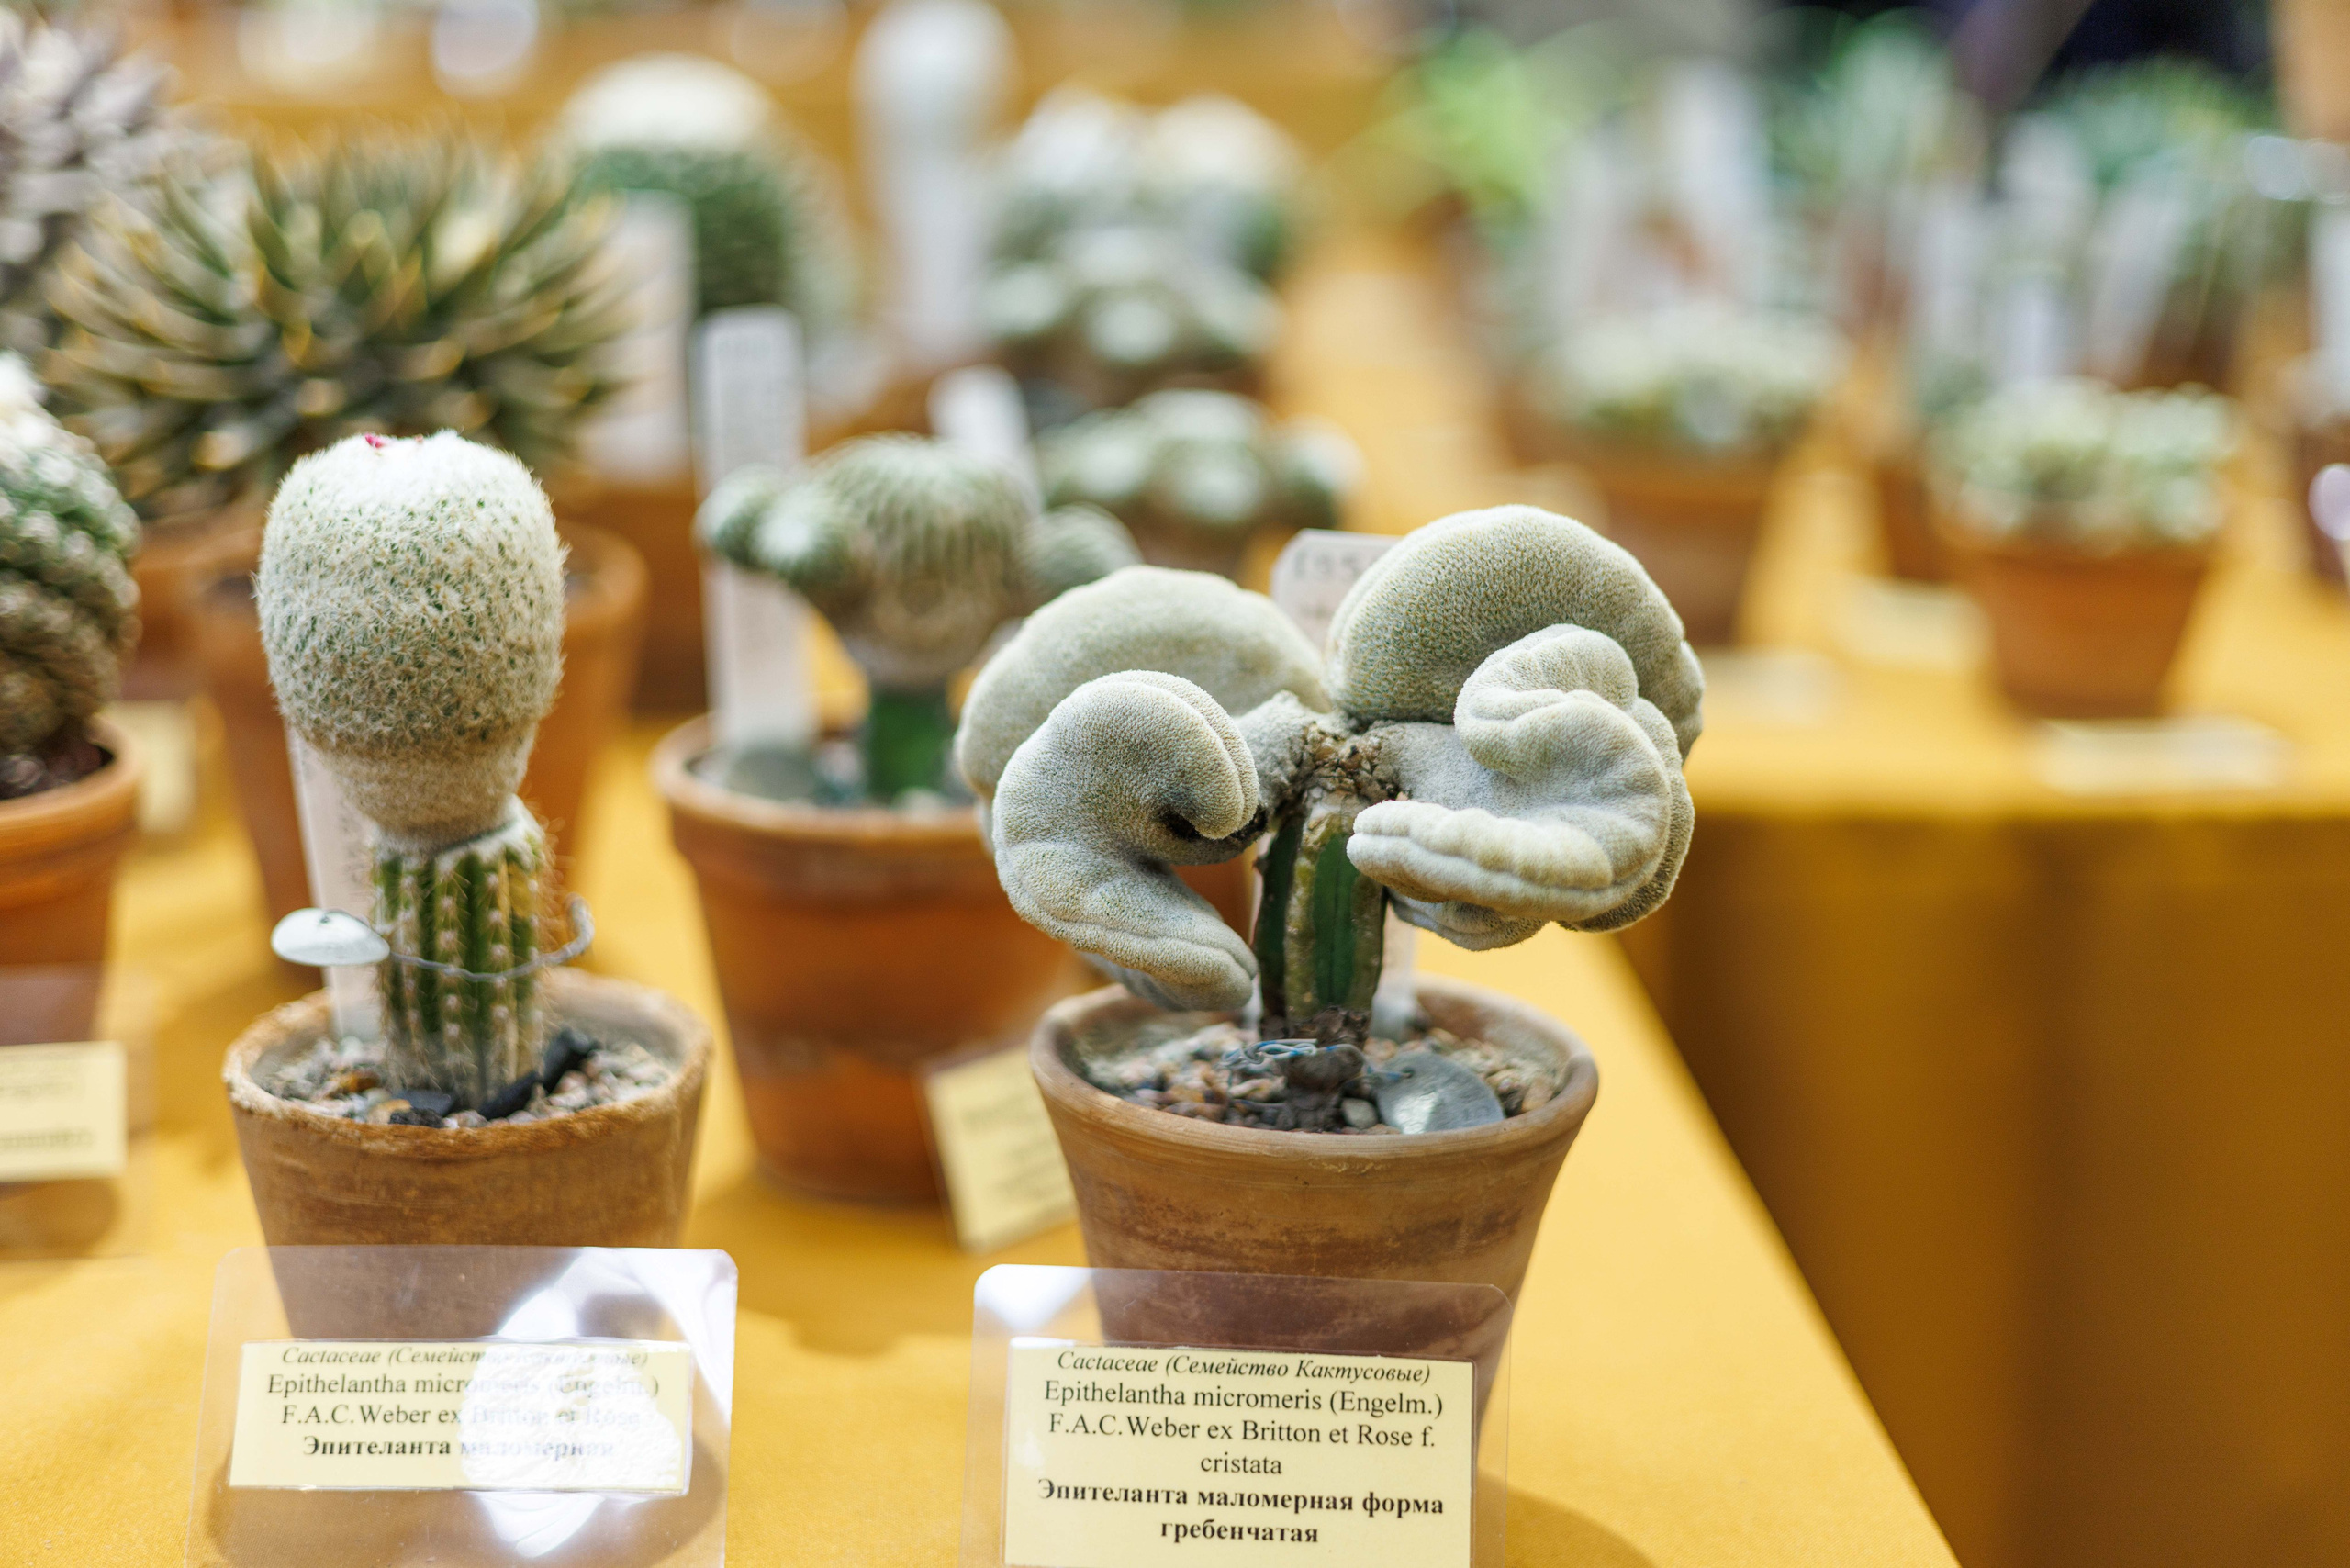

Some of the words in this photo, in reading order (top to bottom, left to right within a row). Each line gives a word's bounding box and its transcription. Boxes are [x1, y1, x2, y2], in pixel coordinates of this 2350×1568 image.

[283, 1346, 381, 1363] Cactaceae
[1058, 1350, 1158, 1372] Cactaceae
[1165, 1354, 1289, 1377] (Семейство
[1295, 1359, 1430, 1385] Кактусовые)
[268, 1373, 406, 1398] Epithelantha
[1045, 1380, 1186, 1406] Epithelantha
[1192, 1385, 1322, 1410] micromeris
[1329, 1389, 1443, 1419] (Engelm.)
[438, 1411, 461, 1424] ex
[555, 1409, 576, 1424] et
[1048, 1412, 1200, 1439] F.A.C.Weber
[1207, 1423, 1233, 1440] ex
[1242, 1420, 1320, 1443] Britton
[1328, 1428, 1348, 1444] et
[1357, 1424, 1413, 1447] Rose
[1420, 1426, 1435, 1448] f.
[303, 1435, 451, 1456] Эпителанта
[1200, 1451, 1282, 1474] cristata
[1037, 1478, 1188, 1505] Эпителанта
[1197, 1489, 1354, 1515] маломерная
[1362, 1491, 1444, 1518] форма
[1160, 1518, 1318, 1544] гребенчатая
